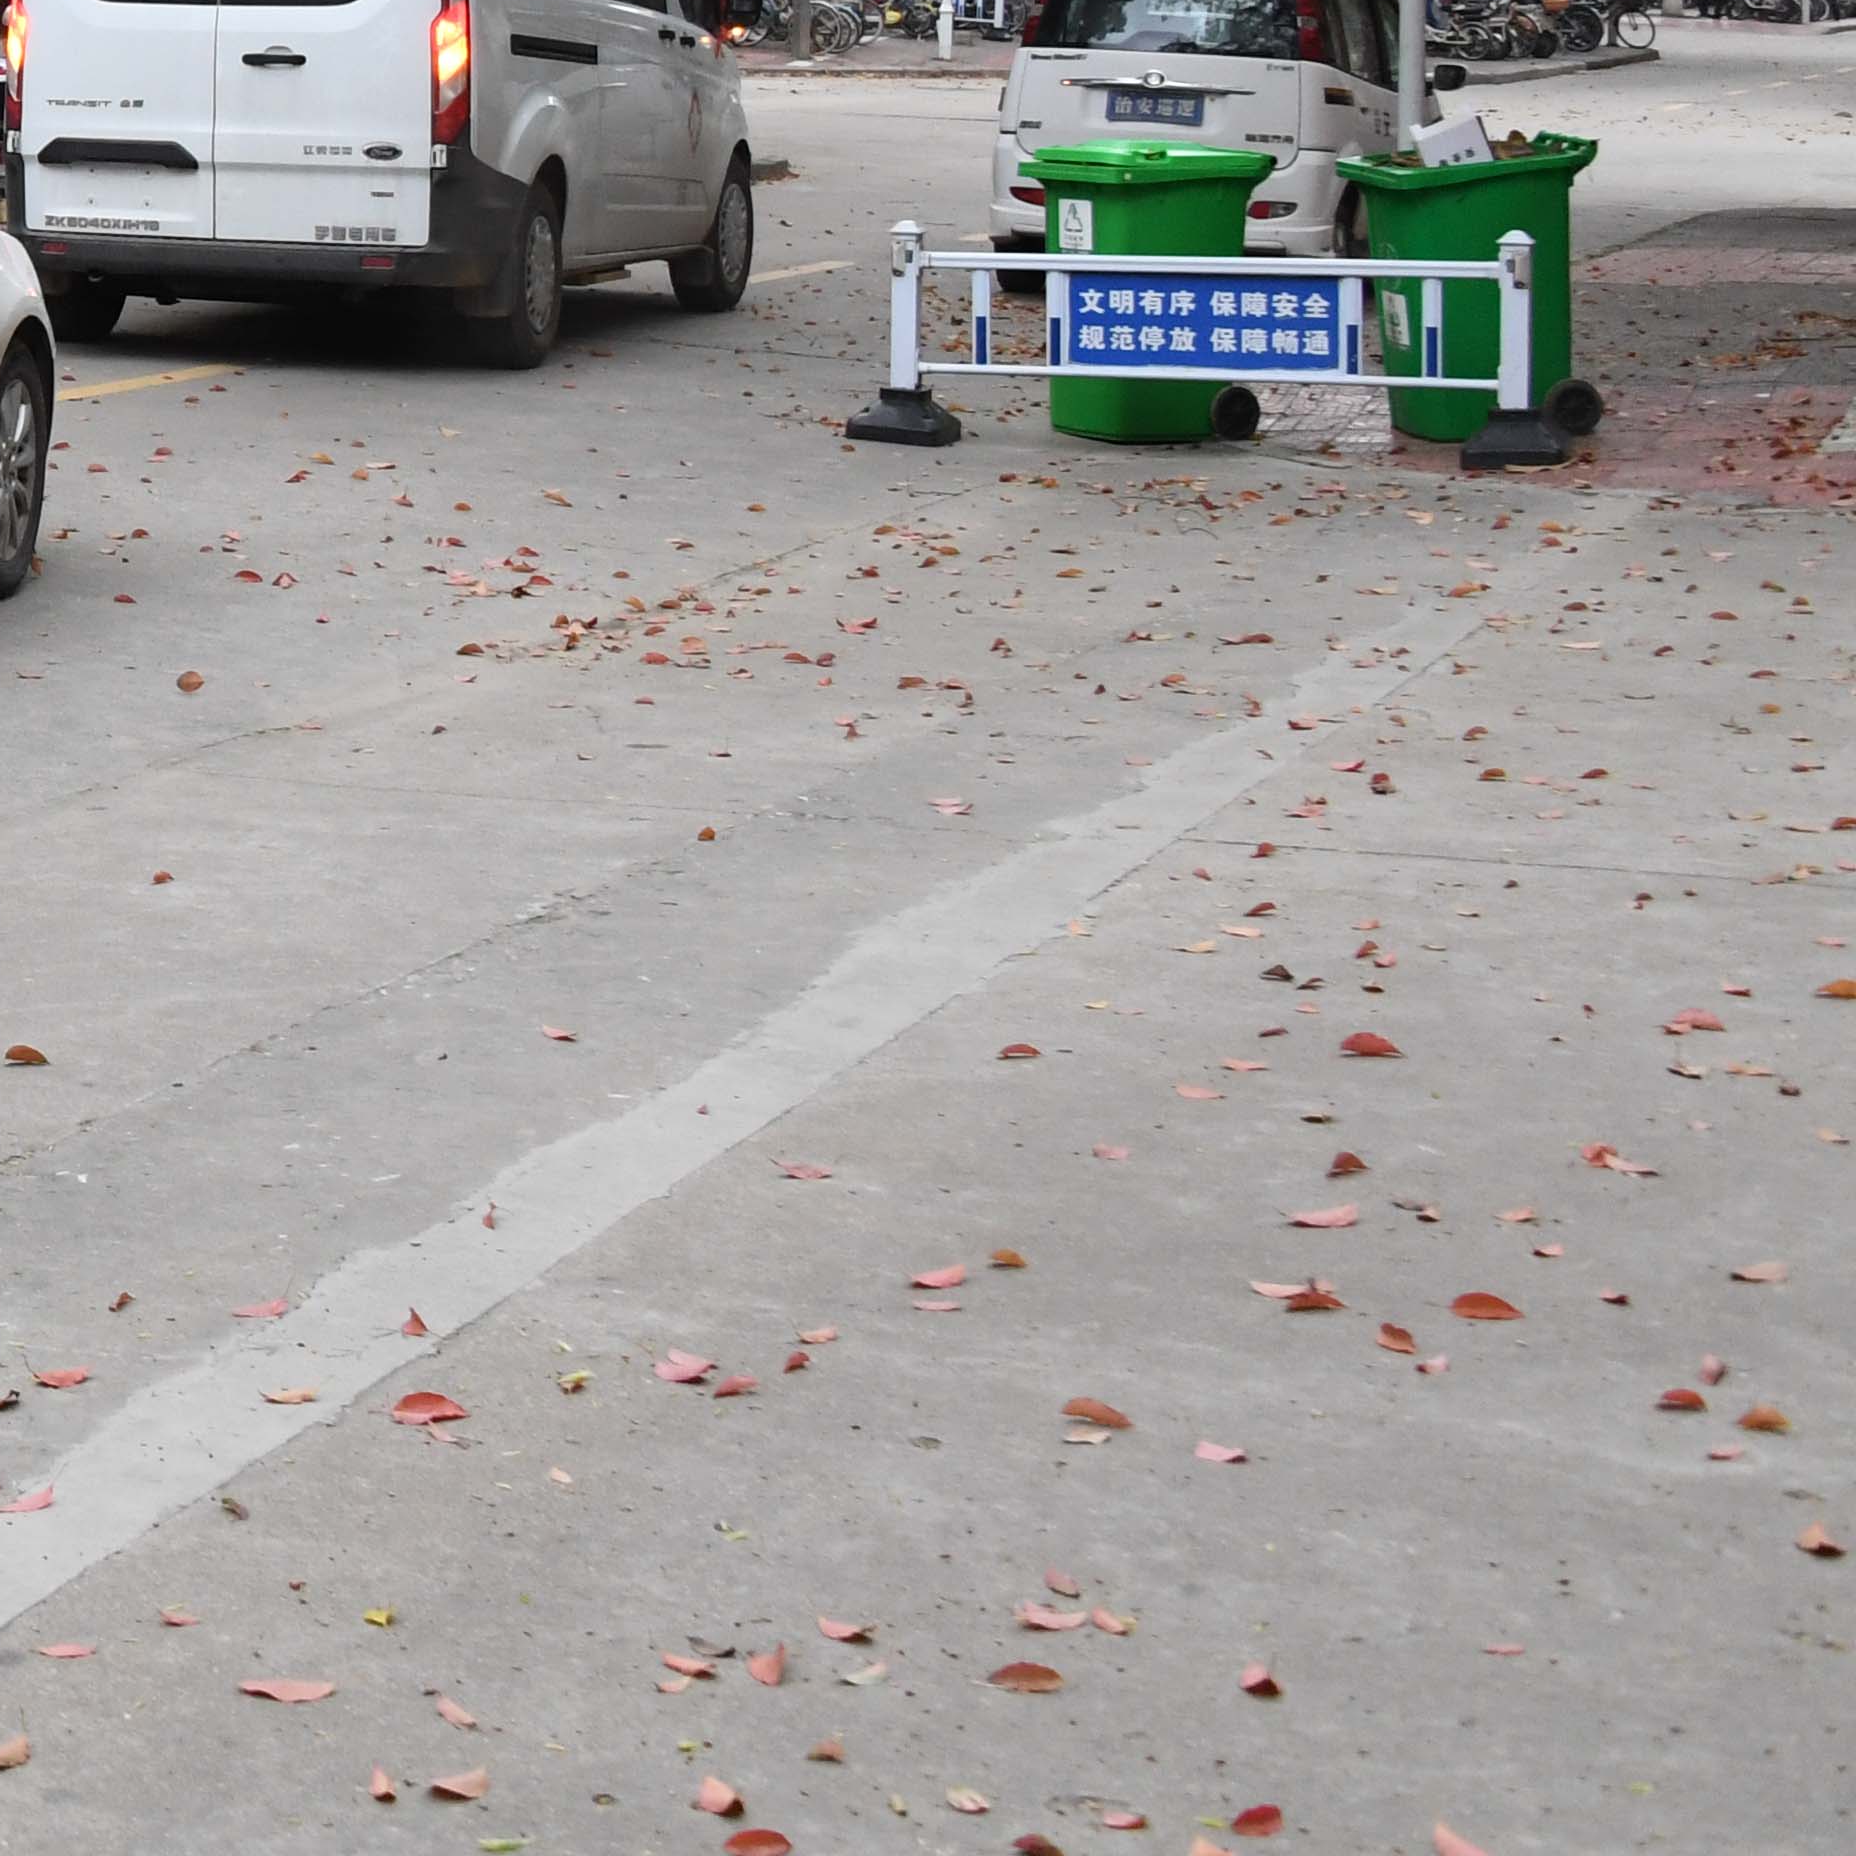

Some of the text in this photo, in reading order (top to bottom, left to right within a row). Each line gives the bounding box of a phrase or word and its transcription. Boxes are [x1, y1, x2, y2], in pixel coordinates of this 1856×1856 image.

[1078, 288, 1331, 320] 文明有序 保障安全
[1078, 325, 1331, 356] 规范停放 保障畅通
